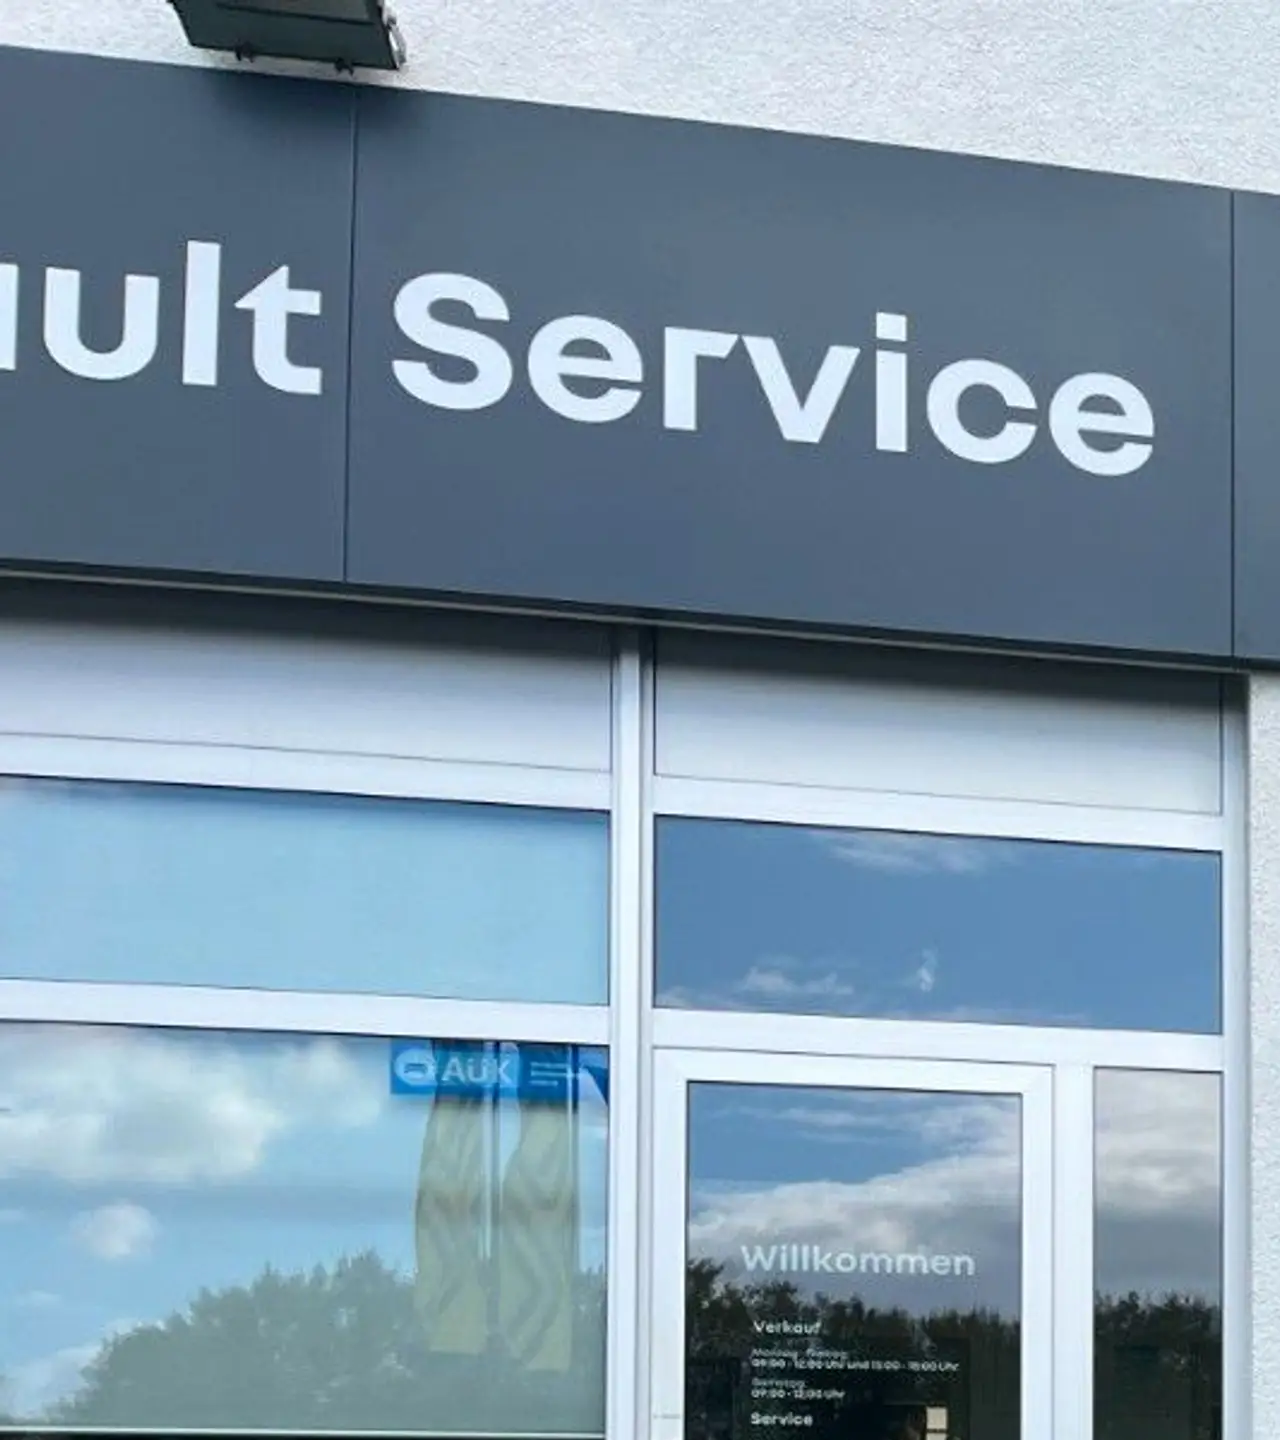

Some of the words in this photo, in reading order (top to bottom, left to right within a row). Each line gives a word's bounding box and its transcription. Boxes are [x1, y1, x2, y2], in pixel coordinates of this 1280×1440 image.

[0, 239, 323, 396] ult
[391, 271, 1156, 477] Service
[740, 1243, 976, 1276] Willkommen
[752, 1320, 822, 1334] Verkauf
[751, 1412, 814, 1426] Service
